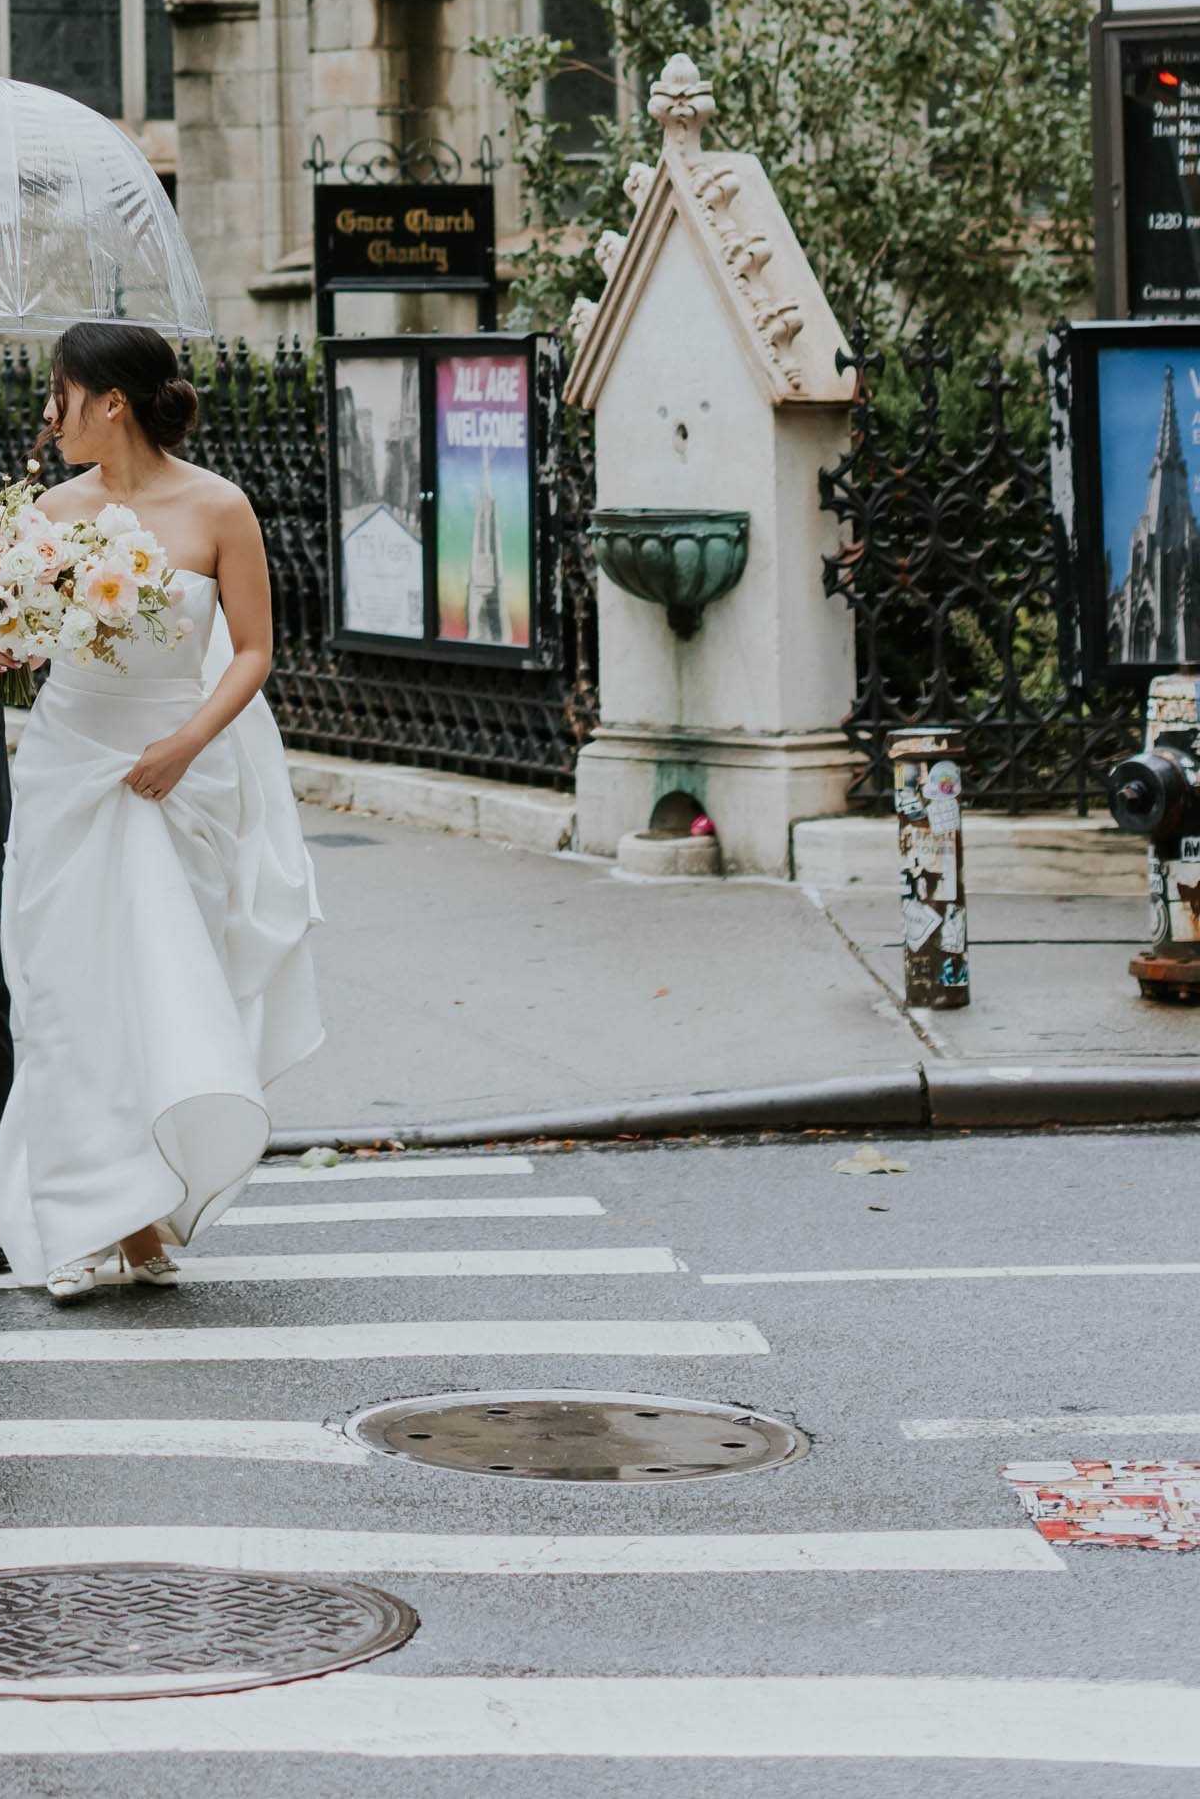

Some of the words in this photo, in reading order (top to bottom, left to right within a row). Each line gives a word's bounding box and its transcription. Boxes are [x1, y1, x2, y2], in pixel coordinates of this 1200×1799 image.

[336, 208, 394, 235] Grace
[404, 207, 475, 236] Church
[1148, 211, 1183, 230] 1220
[367, 238, 449, 274] Chantry
[453, 366, 482, 403] ALL
[484, 366, 520, 403] ARE
[445, 411, 526, 449] WELCOME
